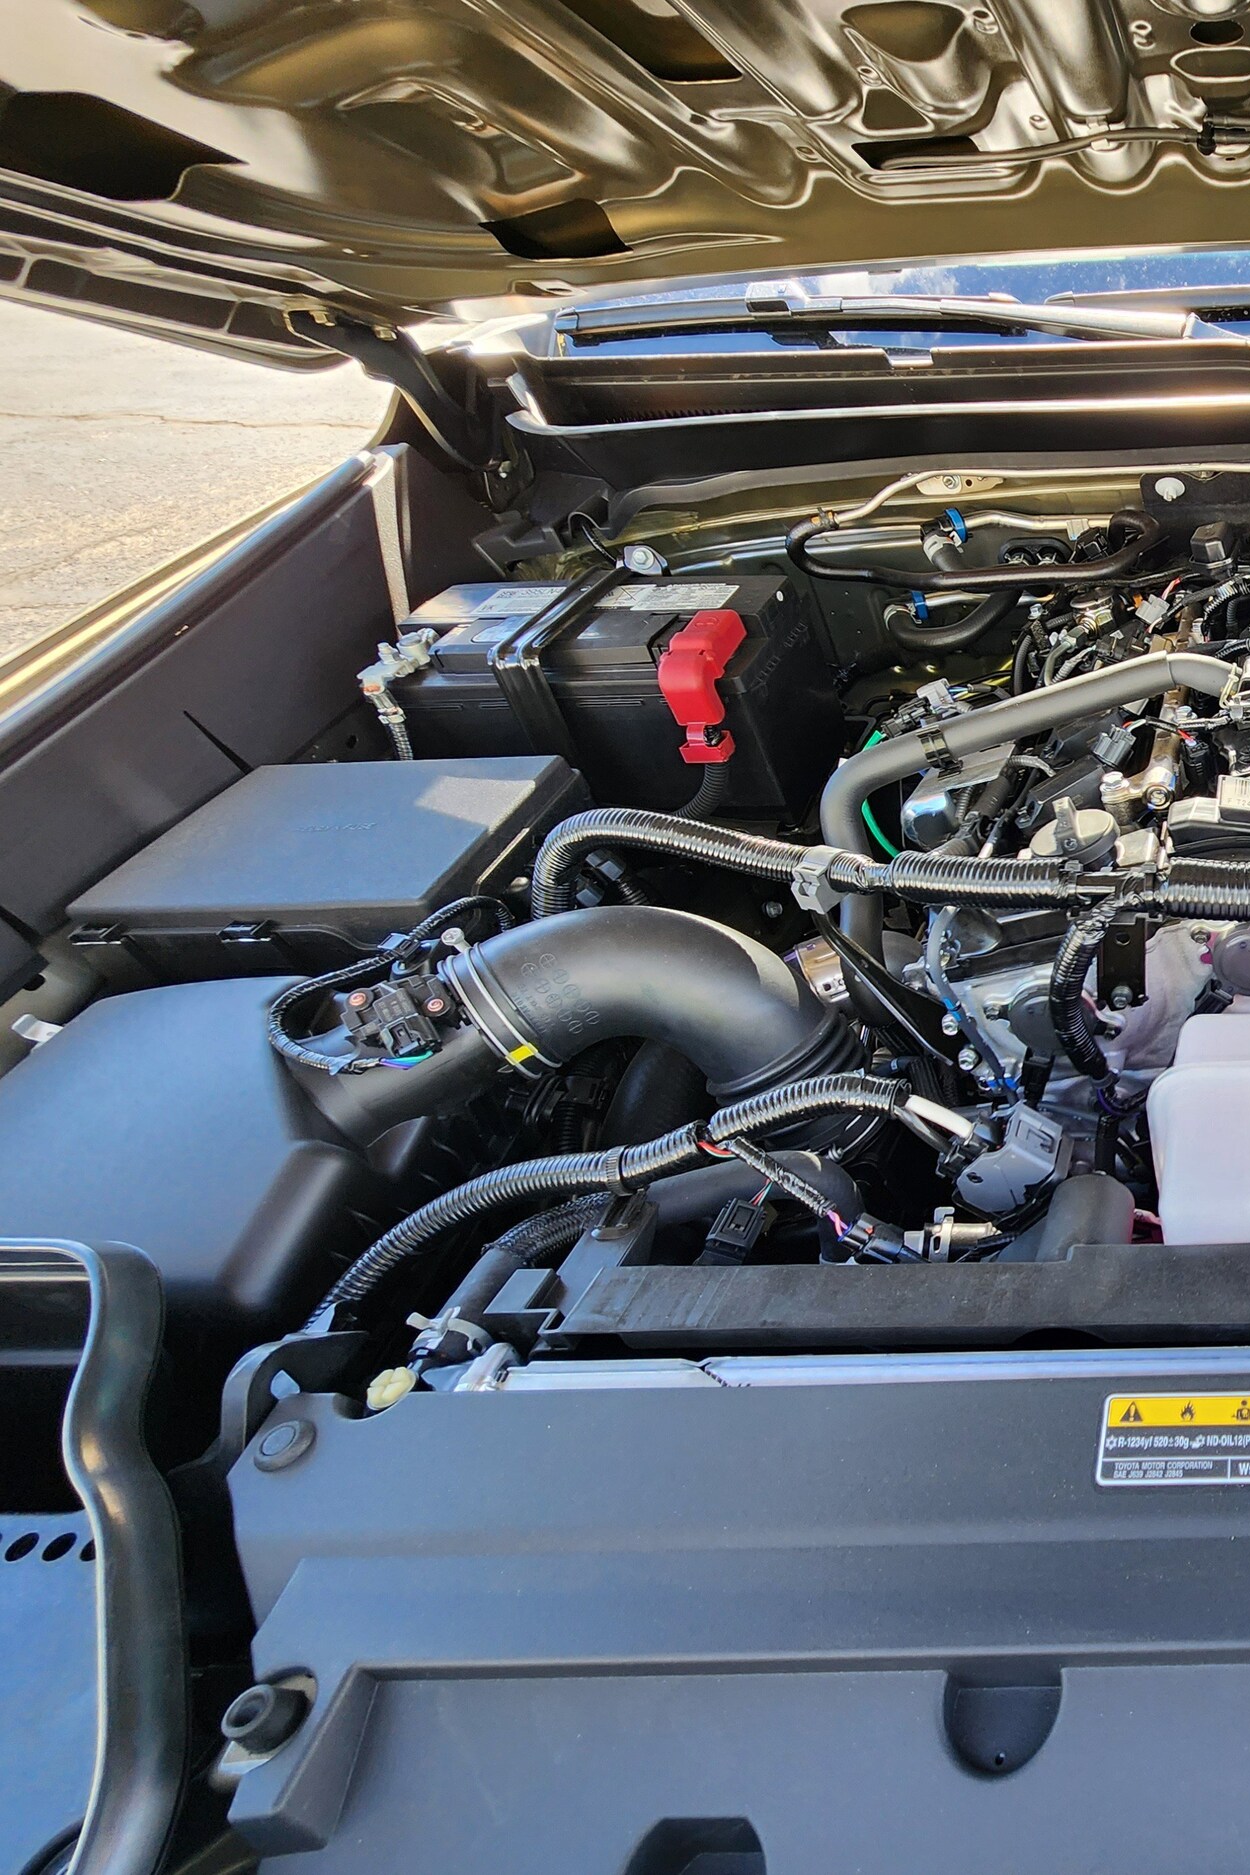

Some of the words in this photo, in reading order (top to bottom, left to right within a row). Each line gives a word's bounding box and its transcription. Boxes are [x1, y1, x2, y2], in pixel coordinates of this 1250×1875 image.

[1117, 1435, 1152, 1450] R-1234yf
[1114, 1462, 1140, 1470] TOYOTA
[1141, 1462, 1165, 1470] MOTOR
[1166, 1461, 1213, 1470] CORPORATION
[1113, 1470, 1127, 1479] SAE
